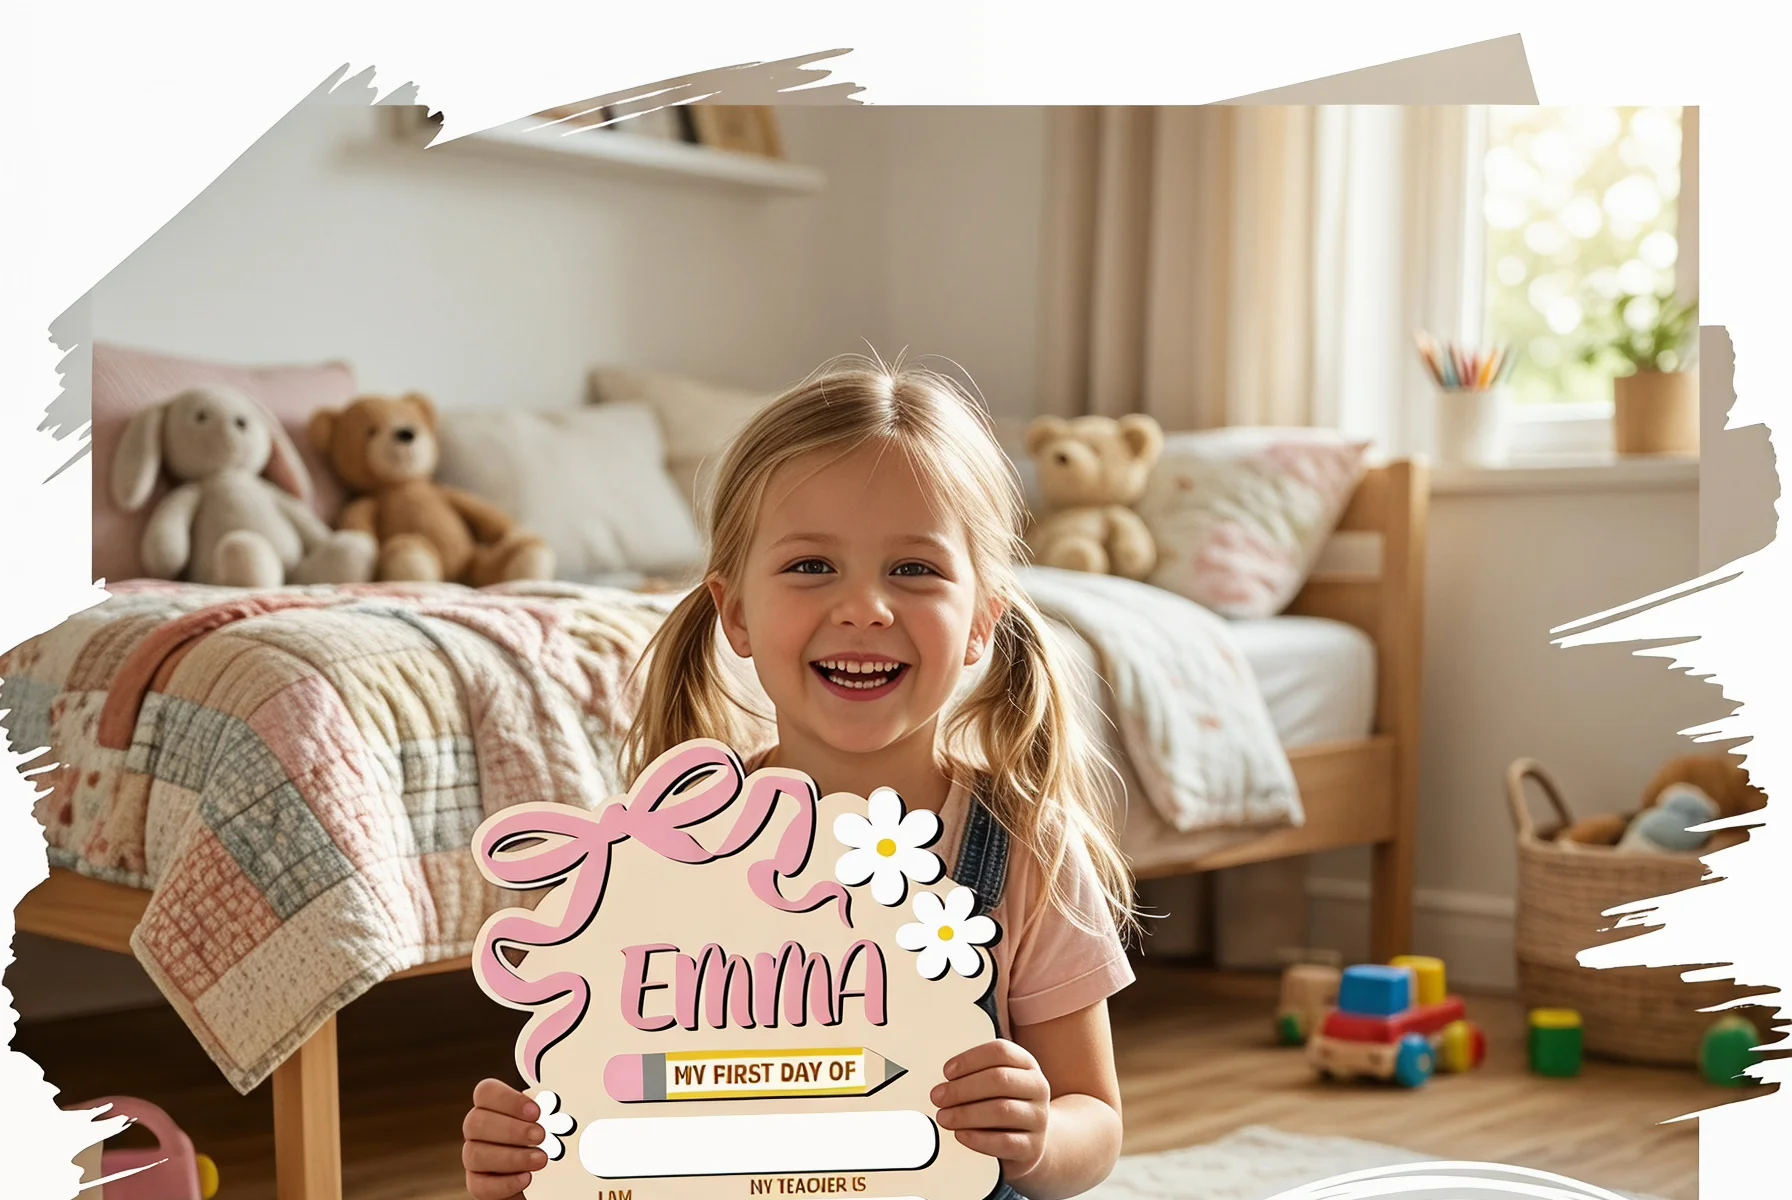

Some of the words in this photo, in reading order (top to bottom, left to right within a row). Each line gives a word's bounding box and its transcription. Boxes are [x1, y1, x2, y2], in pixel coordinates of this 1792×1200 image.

[620, 939, 888, 1031] EMMA
[713, 1062, 774, 1084] FIRST
[781, 1061, 823, 1082] DAY
[829, 1060, 856, 1081] OF
